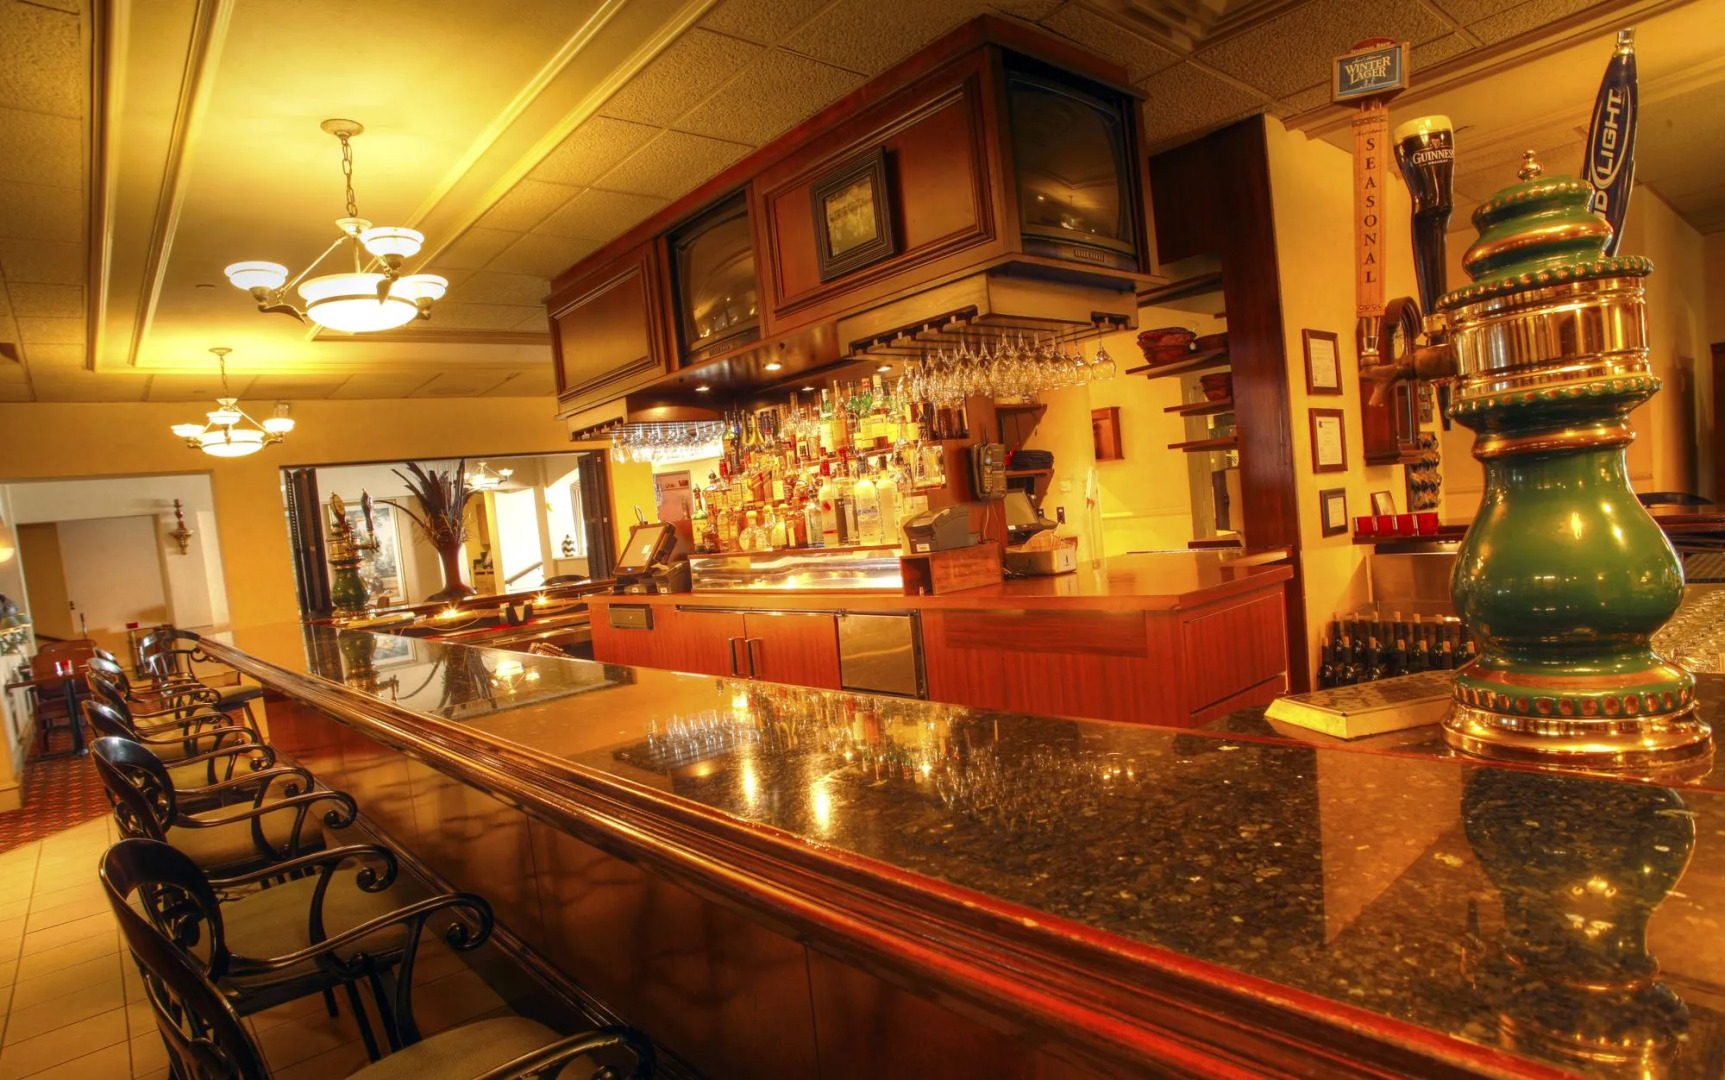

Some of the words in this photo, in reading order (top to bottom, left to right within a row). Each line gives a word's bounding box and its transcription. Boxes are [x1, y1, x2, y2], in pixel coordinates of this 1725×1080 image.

[1345, 56, 1391, 76] WINTER
[1349, 67, 1386, 85] LAGER
[1597, 88, 1622, 176] LIGHT
[1364, 137, 1378, 284] SEASONAL
